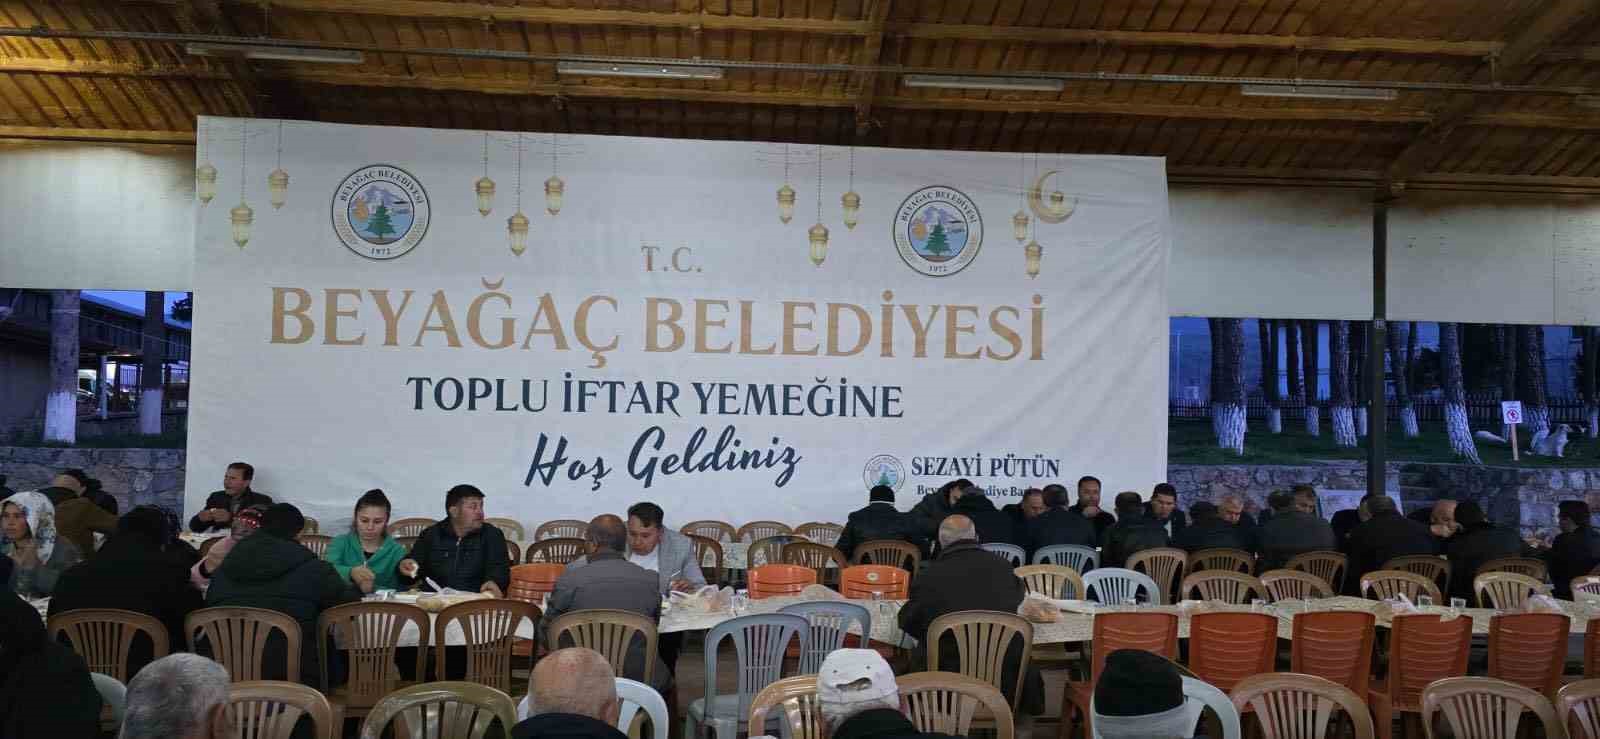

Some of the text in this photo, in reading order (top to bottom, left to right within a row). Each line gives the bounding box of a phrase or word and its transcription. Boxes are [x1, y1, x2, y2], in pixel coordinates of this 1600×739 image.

[641, 245, 703, 273] T.C.
[269, 277, 1047, 368] BEYAĞAÇ BELEDİYESİ
[406, 372, 904, 418] TOPLU İFTAR YEMEĞİNE
[524, 424, 802, 492] Hoş Geldiniz
[911, 452, 984, 477] SEZAYİ
[989, 453, 1060, 478] PÜTÜN
